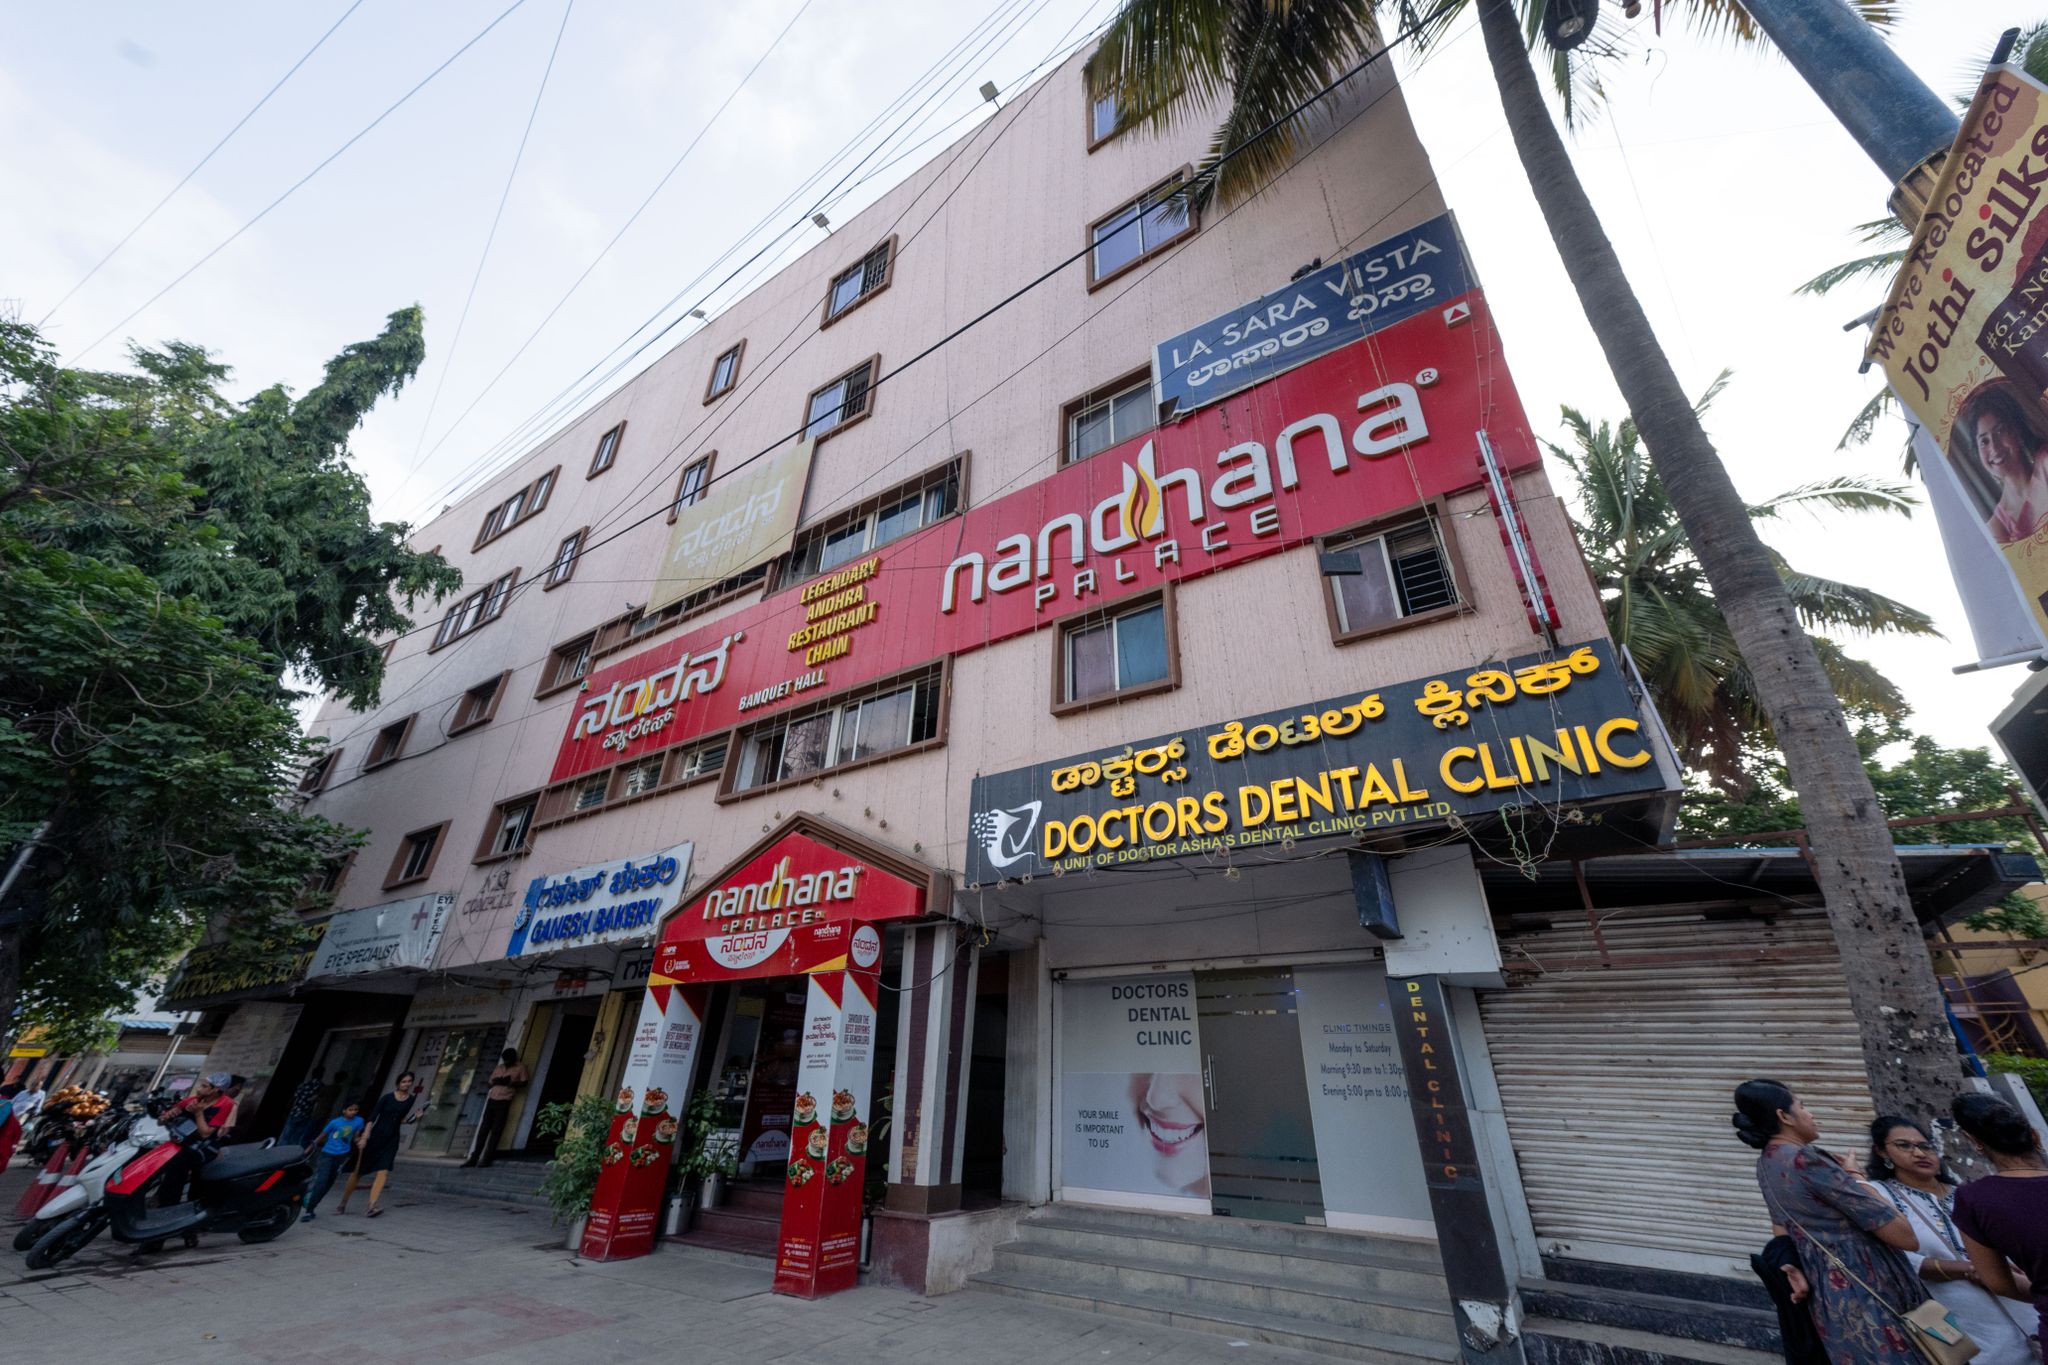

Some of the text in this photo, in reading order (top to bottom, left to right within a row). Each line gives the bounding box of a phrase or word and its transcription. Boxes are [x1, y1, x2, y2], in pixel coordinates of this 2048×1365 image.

[1871, 80, 2020, 361] We've Relocated
[1172, 238, 1442, 369] LA SARA VISTA
[1903, 267, 1975, 402] Jothi
[1986, 309, 2026, 349] #61,
[942, 382, 1430, 613] nandhana
[1035, 504, 1280, 611] PALACE
[800, 557, 880, 604] LEGENDARY
[806, 584, 866, 623] ANDHRA
[787, 601, 879, 652] RESTAURANT
[805, 635, 851, 667] CHAIN
[572, 635, 733, 741] ನಂದನ
[738, 669, 825, 711] BANQUET HALL
[1207, 693, 1385, 760] ಡೆಂಟಲ್
[1414, 646, 1600, 730] ಕ್ಲಿನಿಕ್
[1044, 717, 1652, 858] DOCTORS DENTAL CLINIC
[1064, 856, 1093, 870] UNIT
[1097, 851, 1115, 865] OF
[1118, 843, 1177, 863] DOCTOR
[1240, 826, 1304, 845] DENTAL
[1308, 814, 1367, 834] CLINIC
[1372, 807, 1408, 826] PVT
[1414, 801, 1457, 820] LTD.
[703, 855, 857, 920] nandhana
[530, 897, 662, 945] GANESH BAKERY
[730, 909, 815, 932] PALACE
[324, 951, 345, 969] EYE
[345, 943, 400, 966] SPECIALIST
[720, 931, 769, 954] ನಂದನ
[1112, 983, 1189, 1000] DOCTORS
[1128, 1007, 1191, 1022] DENTAL
[1322, 1023, 1392, 1034] CLINIC TIMINGS
[1406, 982, 1437, 1070] DENTAL
[1136, 1030, 1192, 1046] CLINIC
[1328, 1041, 1392, 1057] Monday to Saturday
[1320, 1063, 1346, 1079] Morning
[1345, 1063, 1361, 1075] 9:30
[1362, 1067, 1372, 1075] am
[1374, 1066, 1381, 1075] to
[1322, 1084, 1347, 1101] Evening
[1346, 1085, 1363, 1097] 5:00
[1364, 1089, 1375, 1102] pm
[1375, 1088, 1382, 1097] to
[1384, 1085, 1402, 1097] 8:00
[1075, 1124, 1124, 1135] IS IMPORTANT
[1077, 1109, 1119, 1120] YOUR SMILE
[1427, 1080, 1458, 1179] CLINIC
[1088, 1138, 1109, 1148] TO US
